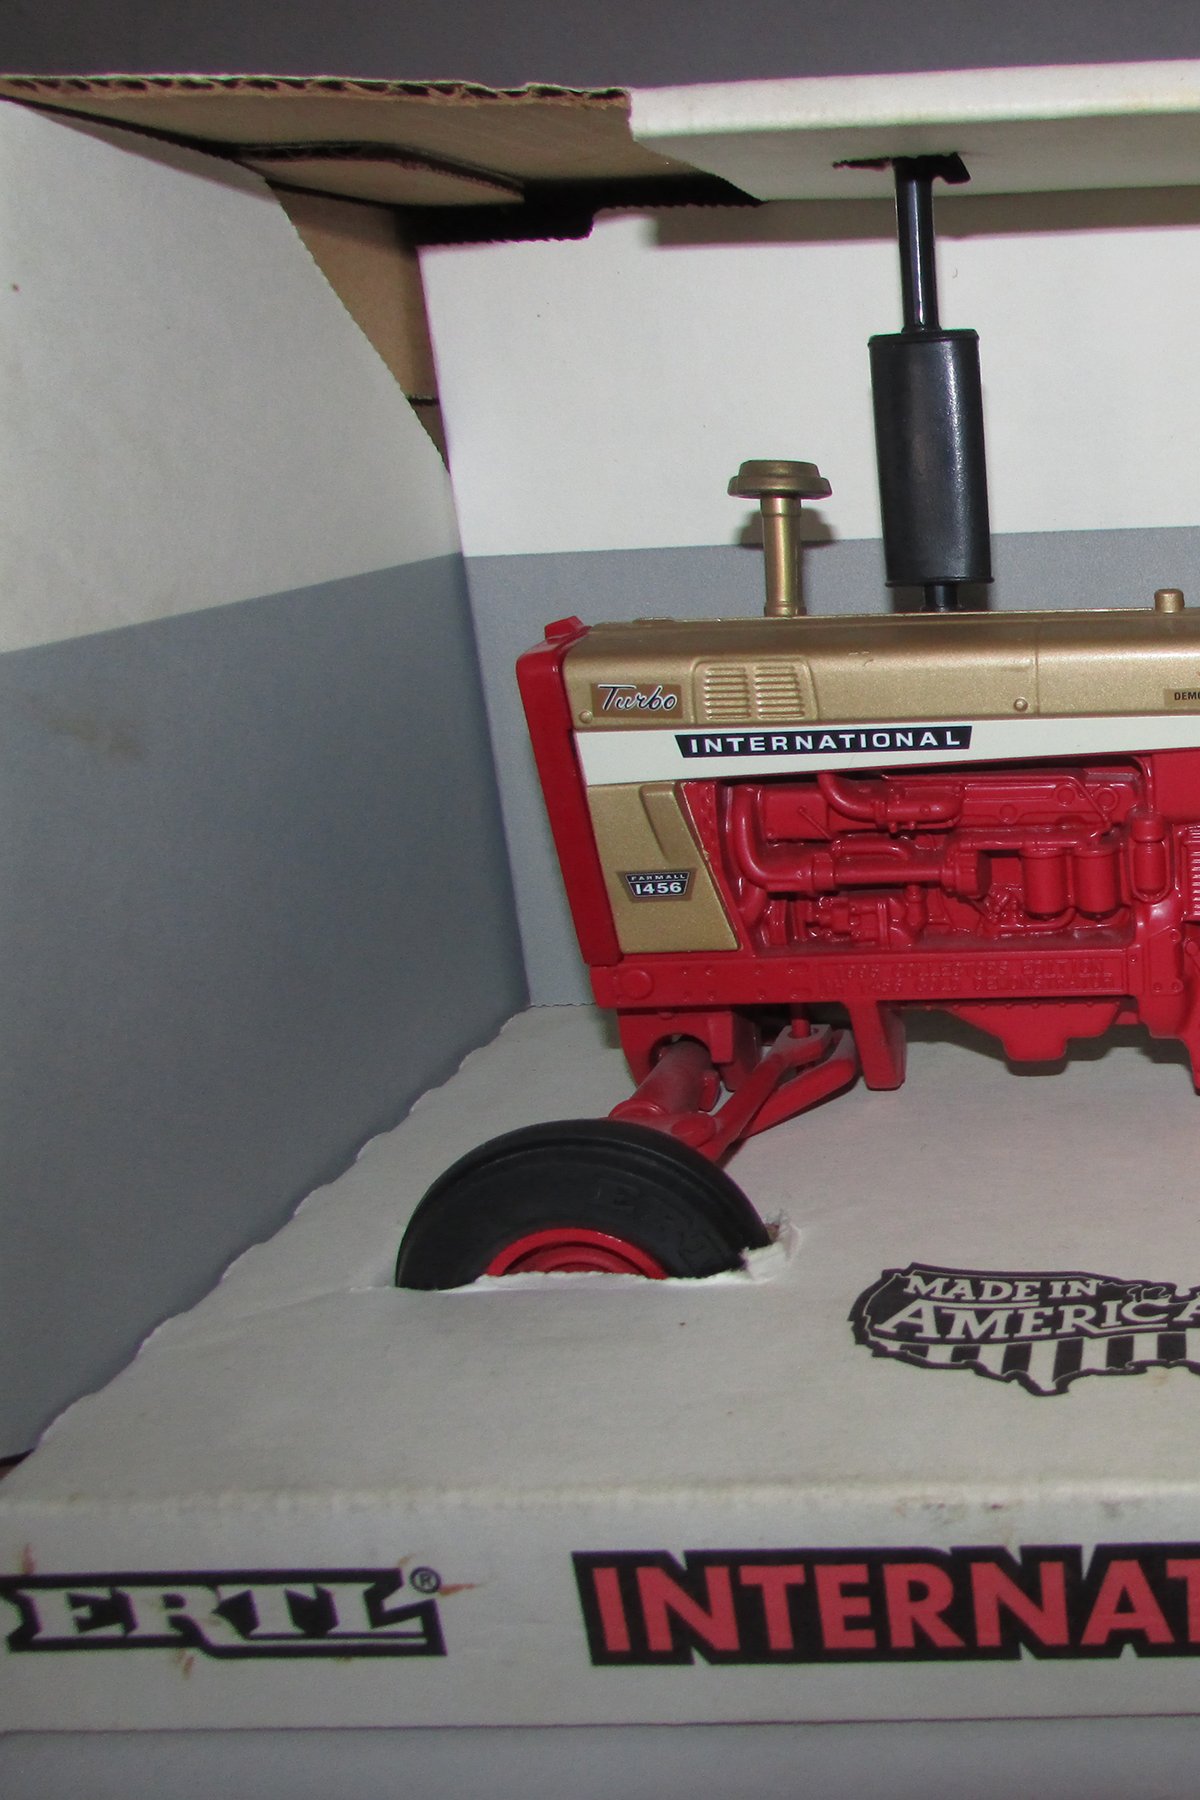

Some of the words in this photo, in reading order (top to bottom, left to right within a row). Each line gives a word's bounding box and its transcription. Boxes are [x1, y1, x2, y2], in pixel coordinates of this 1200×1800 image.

[598, 683, 679, 712] Turbo
[690, 729, 962, 755] INTERNATIONAL
[630, 873, 687, 882] FARMALL
[634, 881, 683, 895] 1456
[904, 1275, 1041, 1302] MADE
[1047, 1277, 1104, 1301] IN
